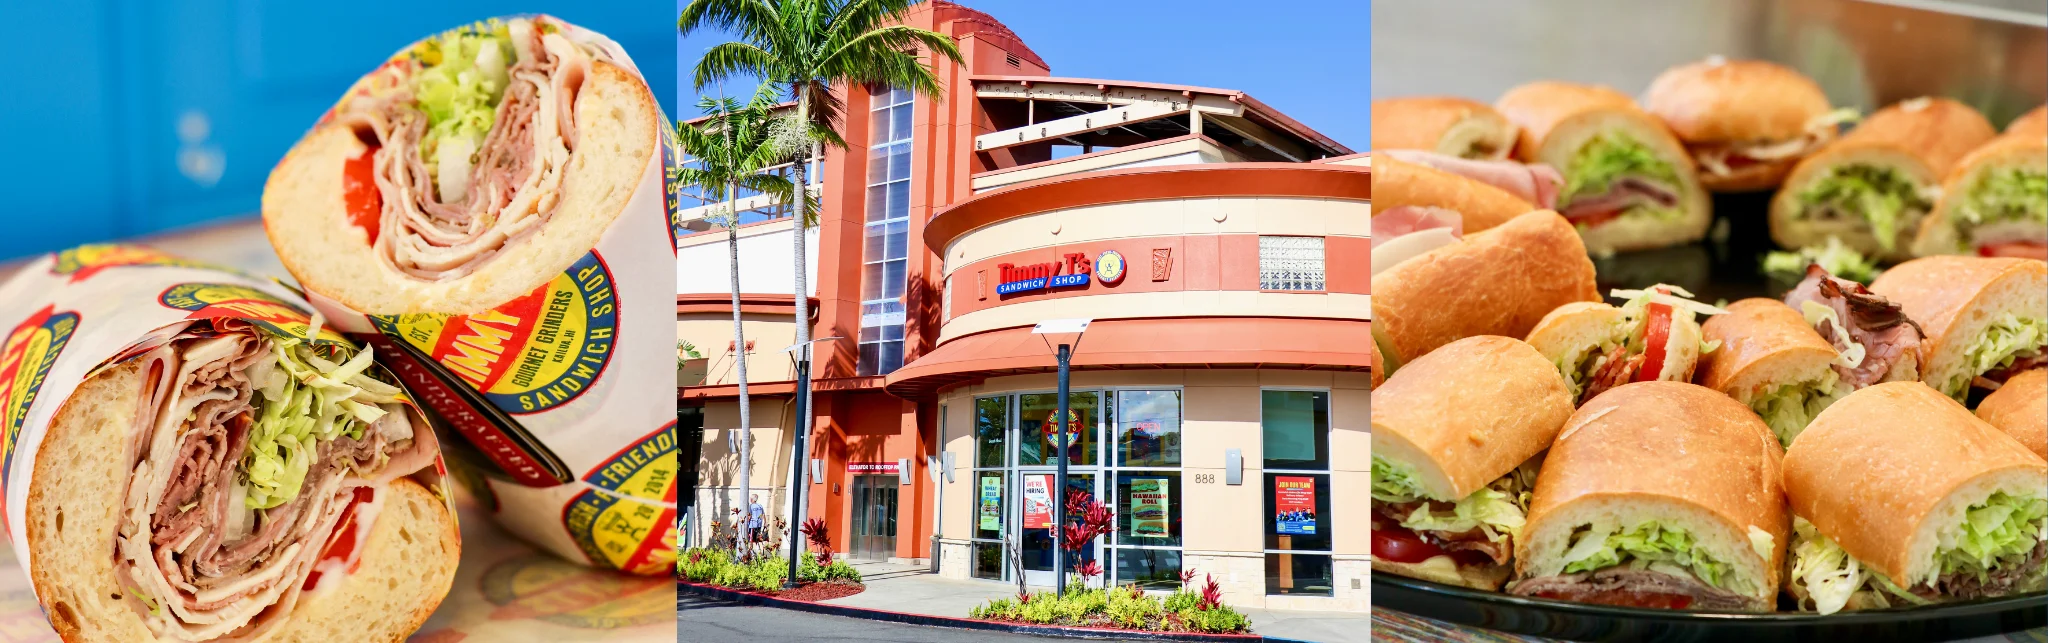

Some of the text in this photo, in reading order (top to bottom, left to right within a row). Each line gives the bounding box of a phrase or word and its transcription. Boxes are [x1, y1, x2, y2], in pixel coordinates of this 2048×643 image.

[997, 261, 1062, 288] Timmy
[1064, 252, 1091, 274] T's
[1000, 280, 1044, 293] SANDWICH
[1055, 275, 1082, 285] SHOP
[440, 310, 521, 391] IMMY
[511, 290, 573, 388] GOURMET GRINDERS
[518, 264, 613, 411] SANDWICH SHOP
[380, 344, 541, 479] HANDCRAFTED
[1136, 422, 1160, 432] OPEN
[643, 468, 670, 495] 2014
[1195, 474, 1215, 484] 888
